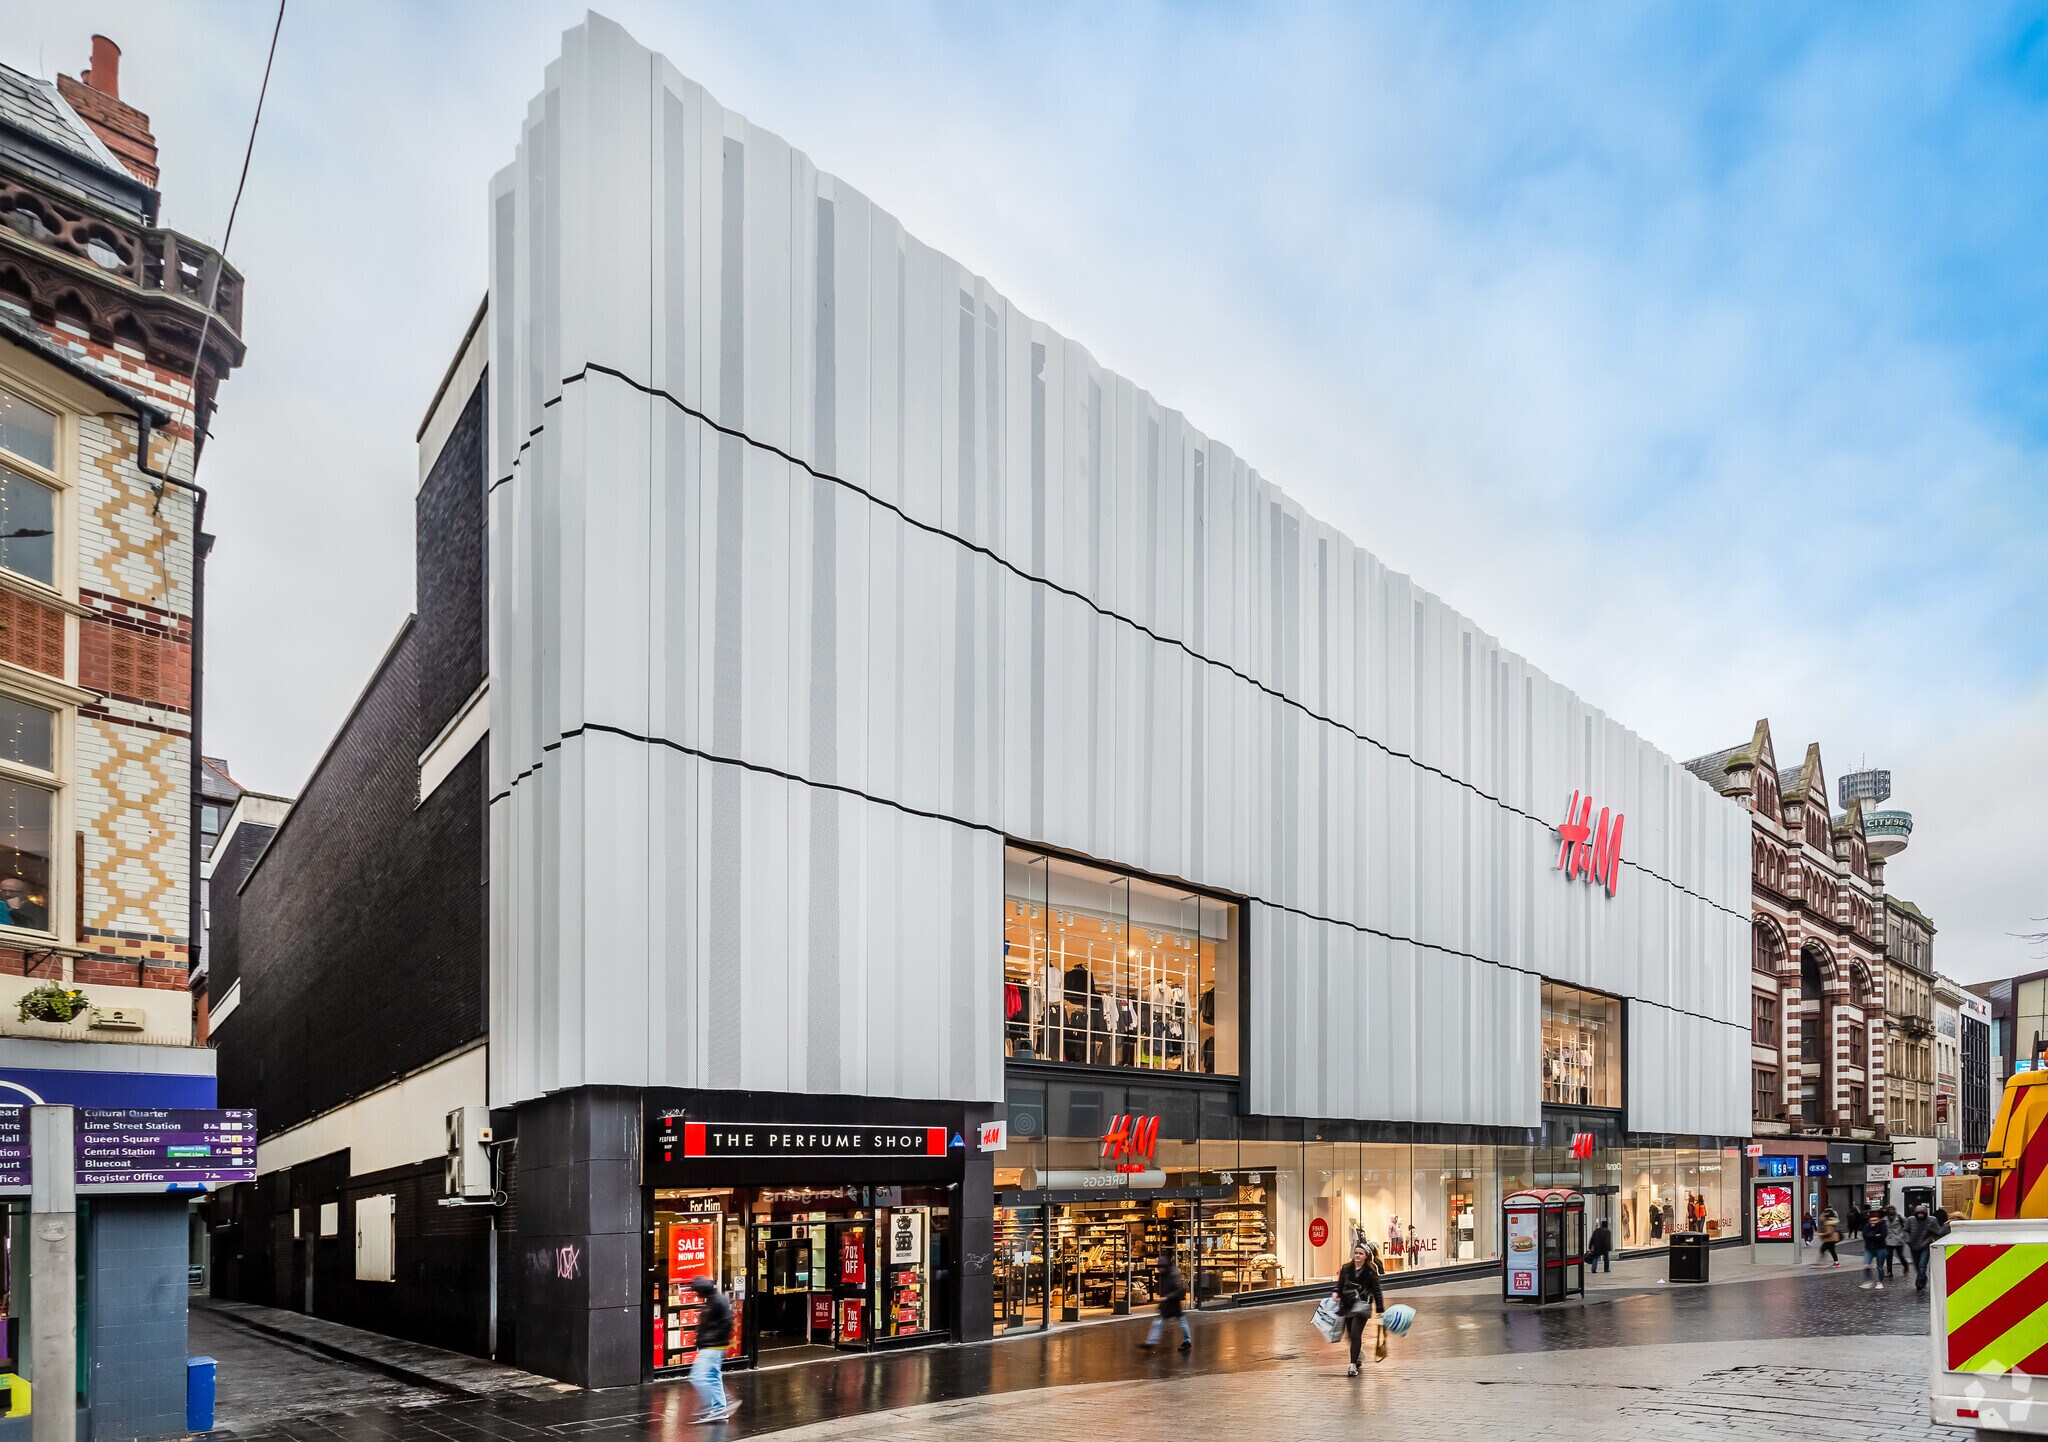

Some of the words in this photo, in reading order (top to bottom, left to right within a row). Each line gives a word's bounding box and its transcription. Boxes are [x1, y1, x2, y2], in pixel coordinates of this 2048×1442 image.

[1867, 818, 1891, 827] CITY
[1556, 789, 1624, 898] H&M
[84, 1110, 126, 1118] Cultural
[129, 1110, 168, 1118] Quarter
[84, 1122, 110, 1130] Lime
[113, 1122, 143, 1130] Street
[146, 1122, 181, 1130] Station
[84, 1135, 120, 1143] Queen
[123, 1135, 160, 1144] Square
[658, 1135, 678, 1143] PERFUME
[713, 1134, 754, 1147] THE
[770, 1134, 861, 1148] PERFUME
[874, 1135, 923, 1148] SHOP
[982, 1127, 1000, 1145] H&M
[1101, 1114, 1160, 1160] H&M
[84, 1148, 122, 1156] Central
[124, 1148, 156, 1156] Station
[84, 1160, 132, 1168] Bluecoat
[1116, 1164, 1146, 1174] HOME
[84, 1174, 131, 1184] Register
[133, 1172, 164, 1181] Office
[690, 1200, 702, 1212] For
[704, 1198, 720, 1212] Him
[678, 1238, 704, 1251] SALE
[1383, 1240, 1410, 1256] FINAL
[1414, 1238, 1437, 1253] SALE
[678, 1252, 694, 1262] NOW
[695, 1252, 705, 1260] ON
[844, 1246, 858, 1260] 70%
[845, 1260, 858, 1274] OFF
[816, 1302, 828, 1311] SALE
[848, 1310, 858, 1320] 70%
[848, 1322, 858, 1332] OFF
